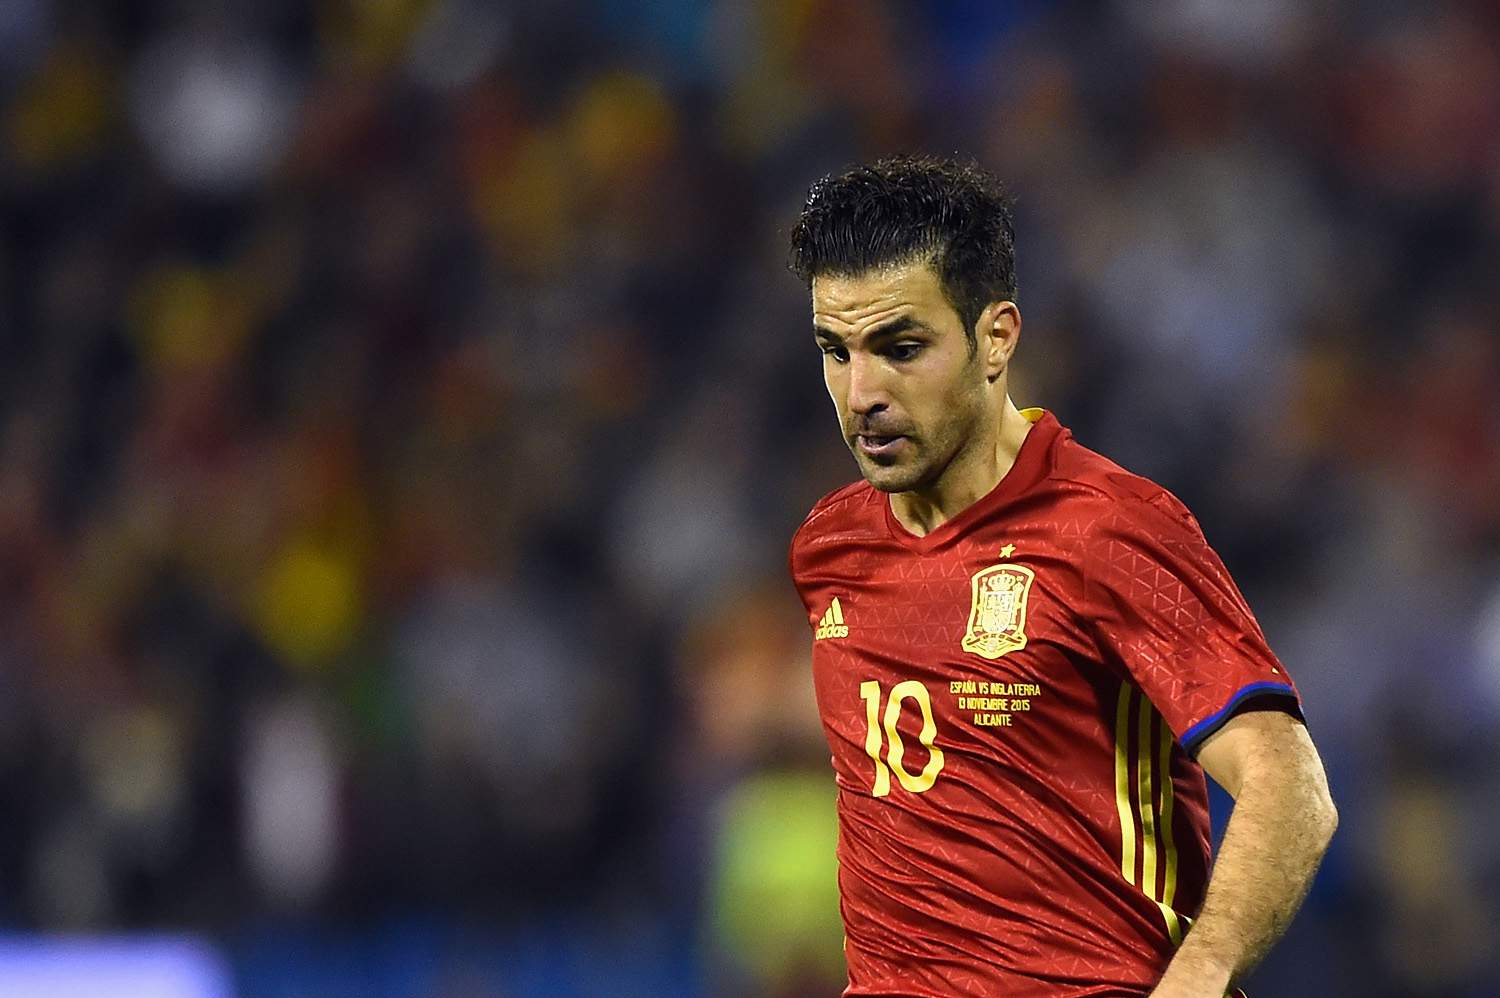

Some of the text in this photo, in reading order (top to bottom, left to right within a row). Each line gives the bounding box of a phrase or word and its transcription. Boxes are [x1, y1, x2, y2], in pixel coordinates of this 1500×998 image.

[816, 624, 848, 640] adidas
[950, 681, 1041, 696] ESPAÑA VS INGLATERRA
[958, 697, 1031, 711] 13 NOVIEMBRE 2015
[974, 713, 1012, 726] ALICANTE
[860, 680, 944, 797] 10
